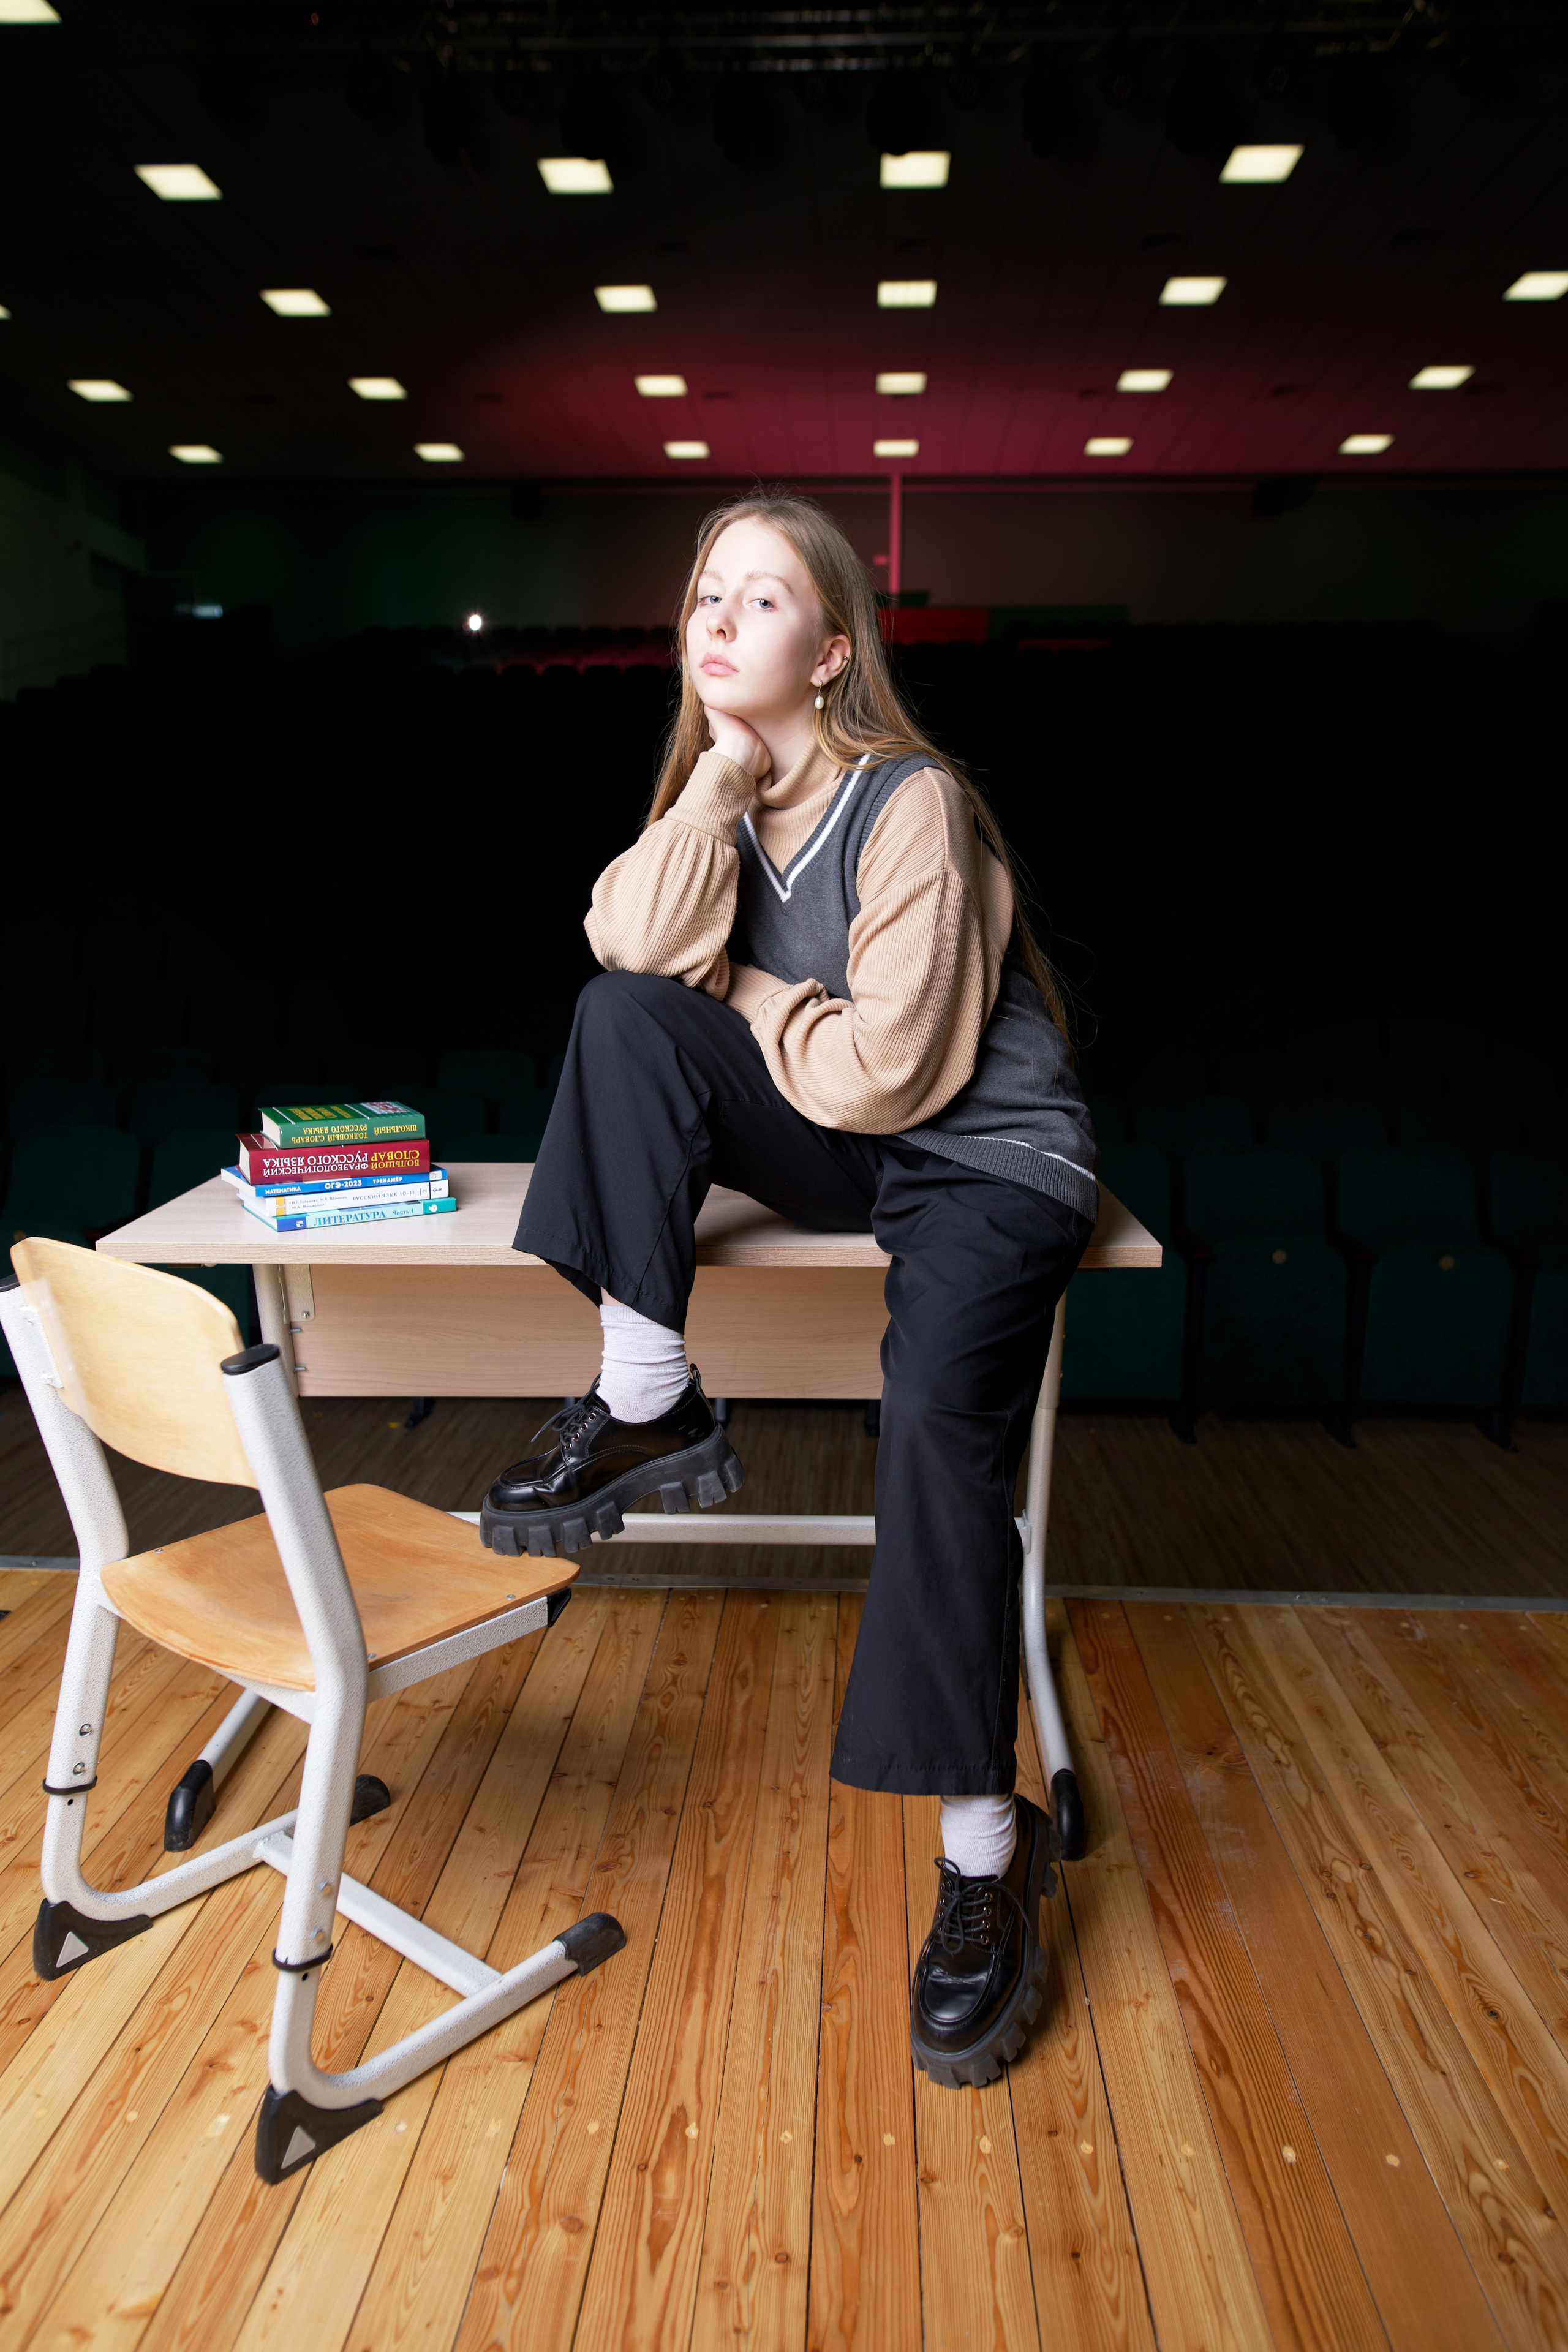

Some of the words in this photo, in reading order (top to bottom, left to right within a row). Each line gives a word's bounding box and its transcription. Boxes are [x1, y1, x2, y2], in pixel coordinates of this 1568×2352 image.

[303, 1125, 330, 1134] ЯЗЫКА
[331, 1124, 368, 1133] РУССКОГО
[374, 1125, 418, 1134] ШКОЛЬНЫЙ
[292, 1134, 325, 1144] СЛОВАРЬ
[327, 1132, 368, 1143] ТОЛКОВЫЙ
[262, 1156, 305, 1168] ЯЗЫКА
[307, 1151, 369, 1166] РУССКОГО
[371, 1159, 420, 1170] БОЛЬШОЙ
[263, 1163, 369, 1177] ФРАЗЕОЛОГИЧЕСКИЙ
[265, 1186, 301, 1195] МАТЕМАТИКА
[428, 1204, 438, 1212] 6
[314, 1210, 386, 1226] ЛИТЕРАТУРА
